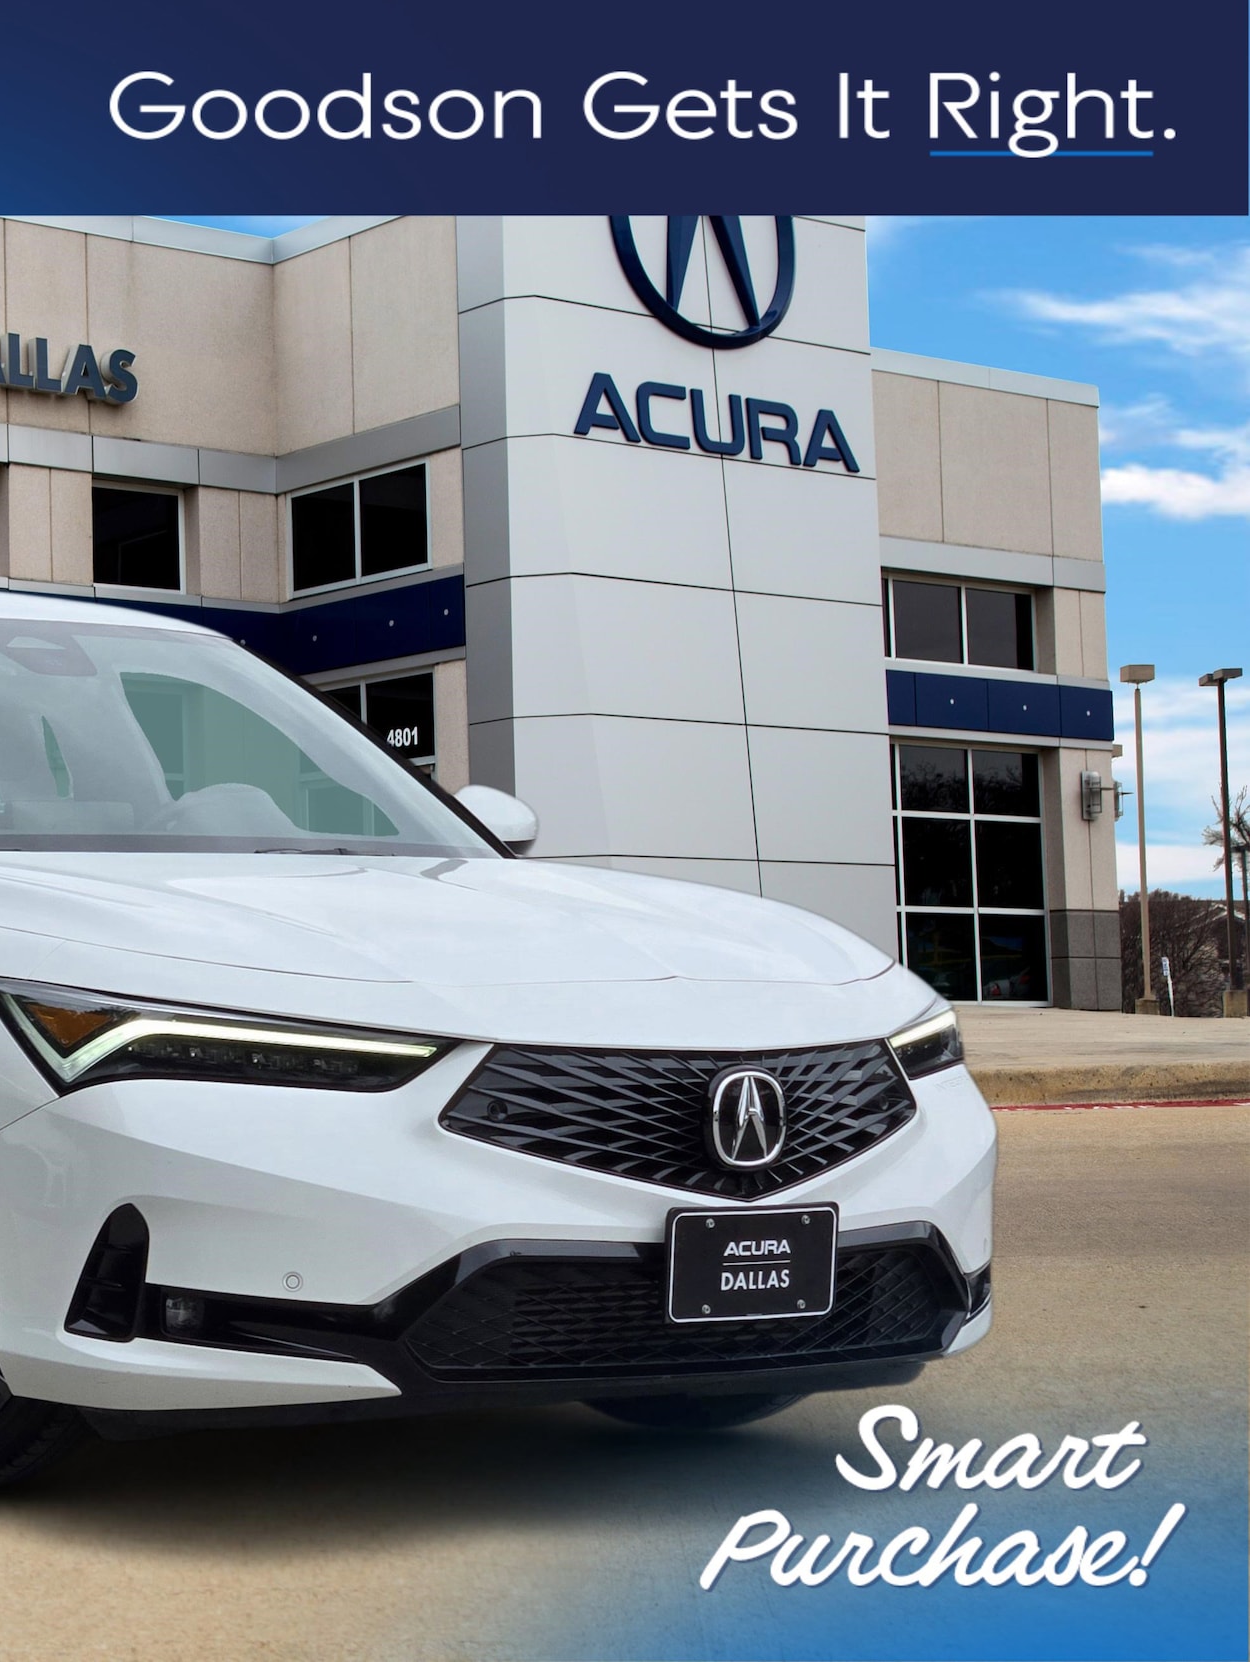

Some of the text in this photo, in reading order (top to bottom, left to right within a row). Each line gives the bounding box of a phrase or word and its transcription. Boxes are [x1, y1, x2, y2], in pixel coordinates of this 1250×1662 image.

[573, 371, 861, 474] ACURA
[386, 726, 418, 748] 4801
[723, 1239, 791, 1257] ACURA
[720, 1268, 790, 1291] DALLAS
